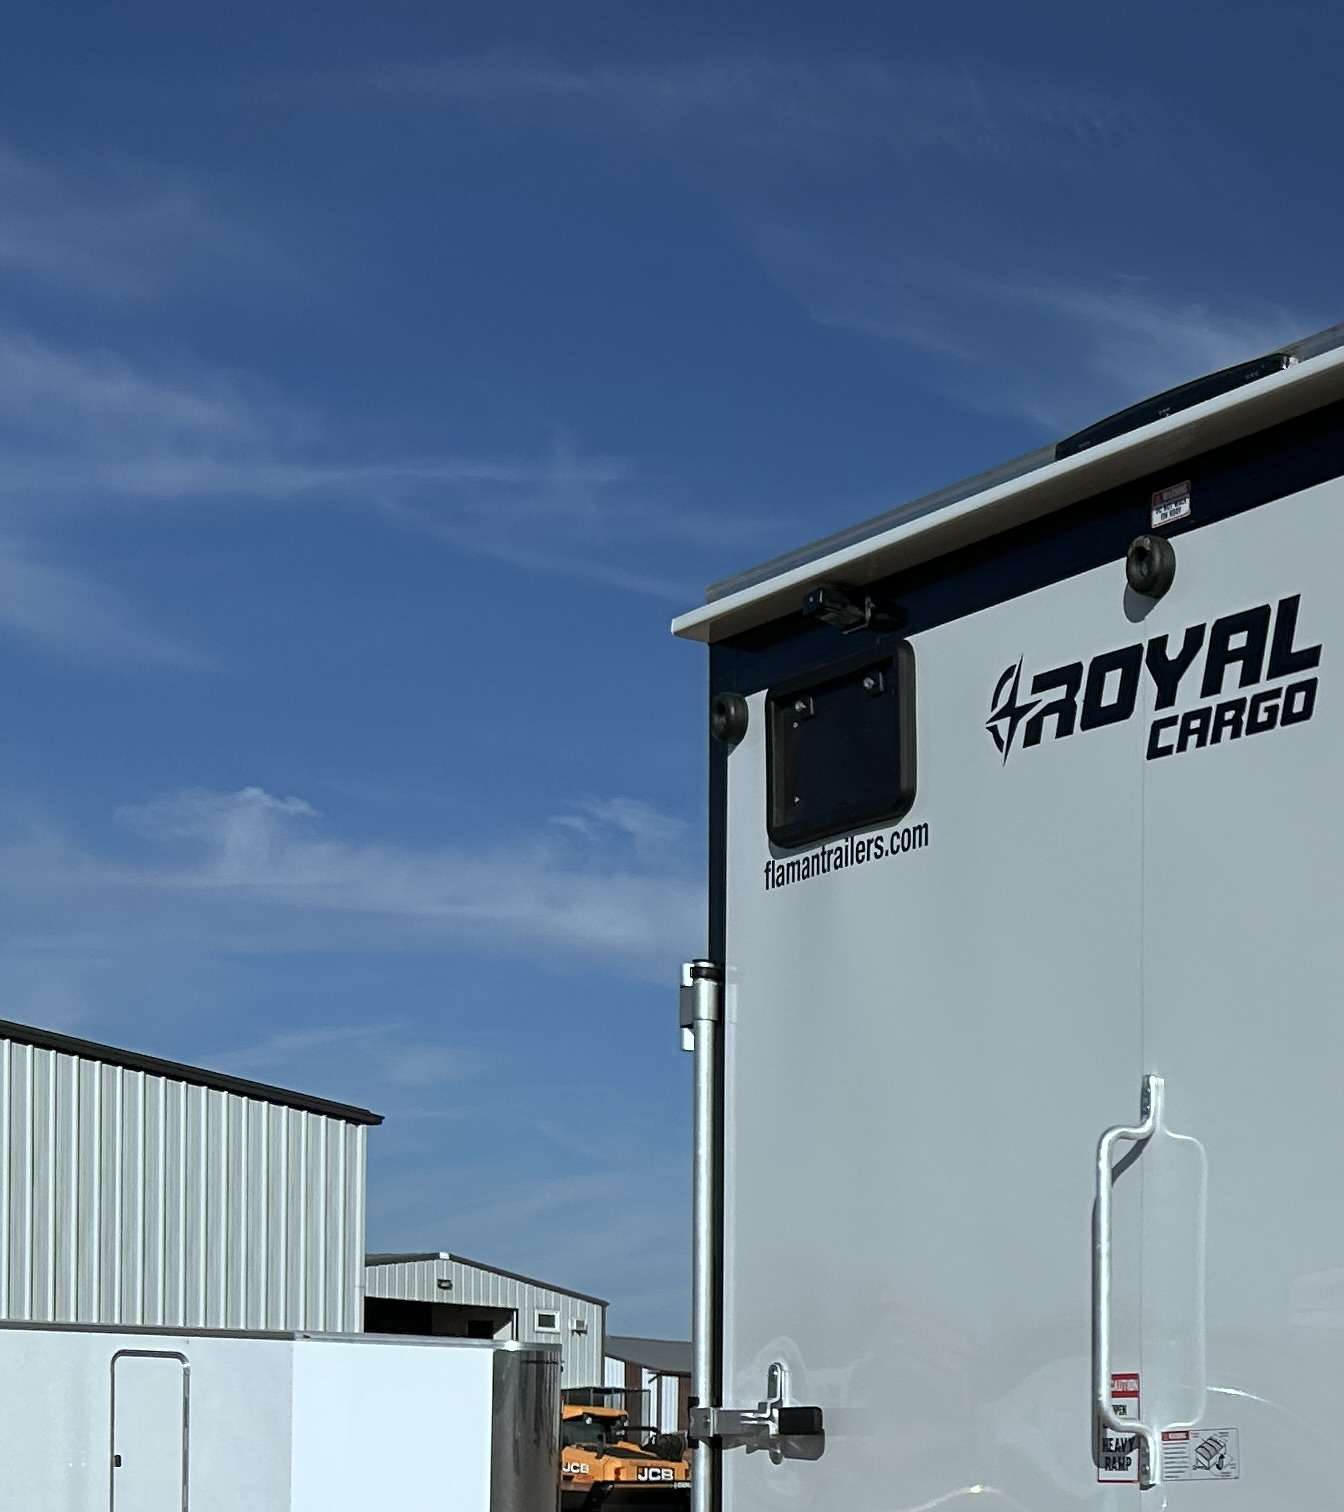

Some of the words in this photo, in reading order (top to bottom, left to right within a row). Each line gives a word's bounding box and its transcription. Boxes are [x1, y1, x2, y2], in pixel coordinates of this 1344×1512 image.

[1022, 592, 1324, 750] ROYAL
[1145, 676, 1320, 762] CARGO
[764, 822, 930, 891] flamantrailers.com
[1102, 1436, 1137, 1453] HEAVY
[562, 1461, 590, 1475] JCB
[1104, 1455, 1133, 1472] RAMP
[637, 1466, 674, 1481] JCB
